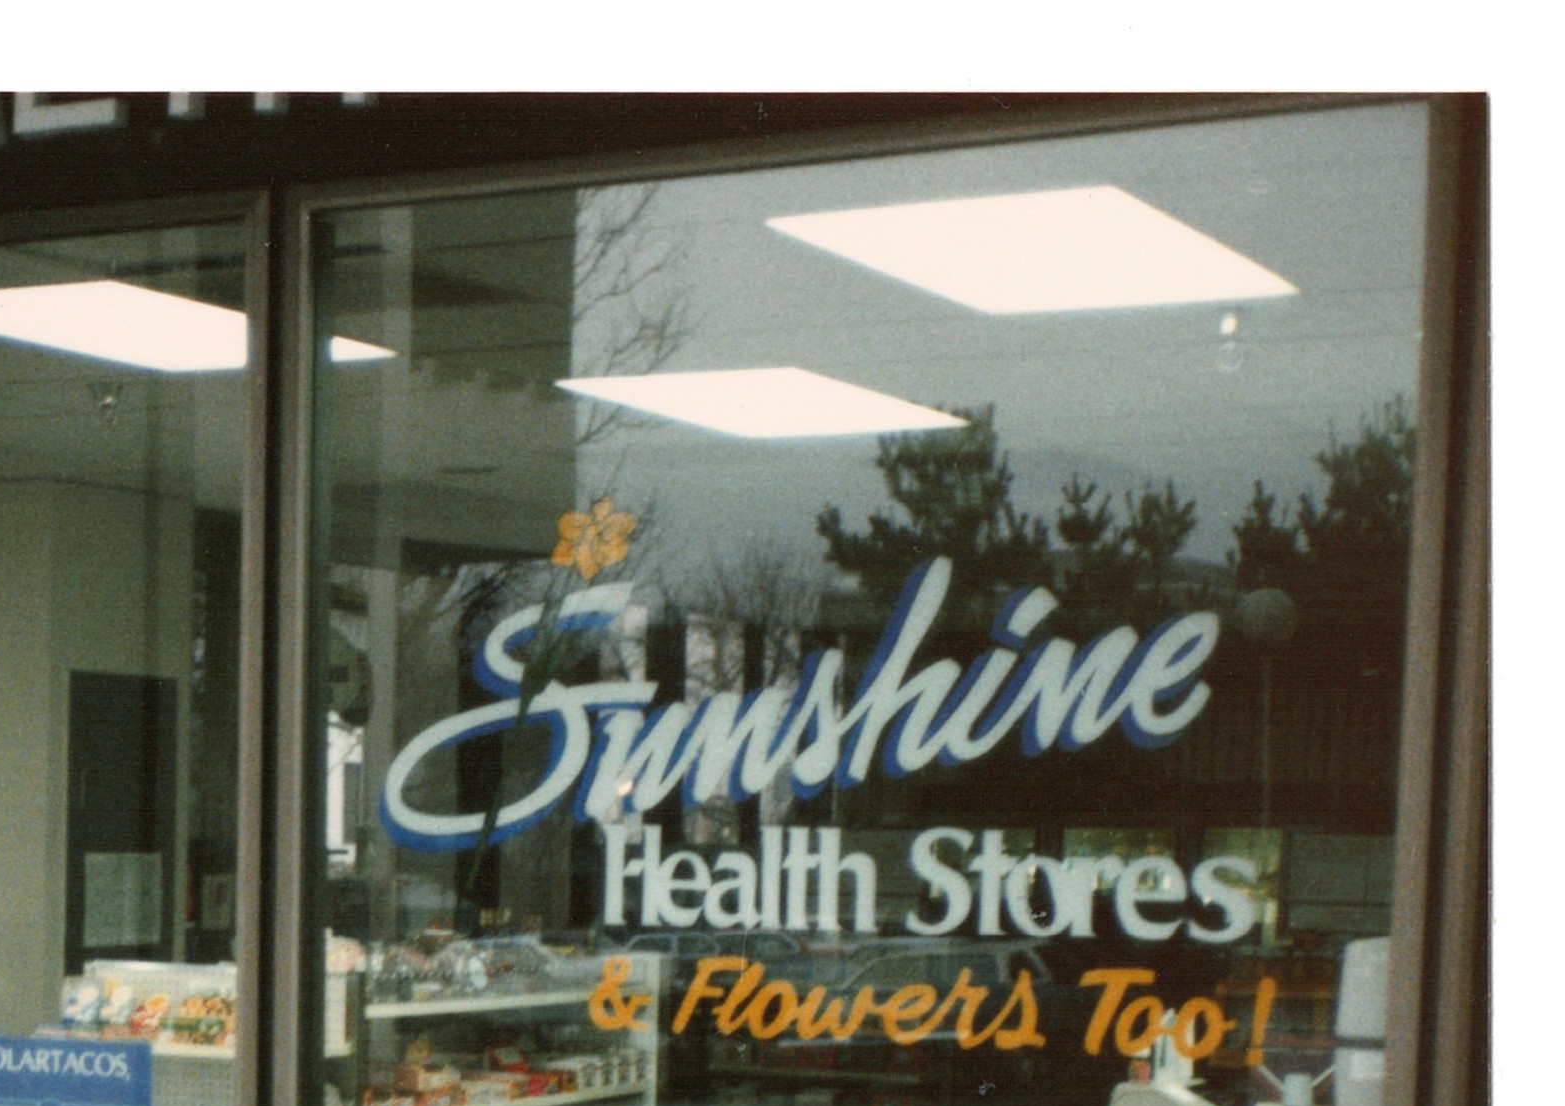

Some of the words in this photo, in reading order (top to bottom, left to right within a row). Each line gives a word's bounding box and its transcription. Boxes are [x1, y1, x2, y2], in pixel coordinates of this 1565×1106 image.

[380, 556, 1220, 852] Sunshine
[603, 825, 877, 932] Health
[907, 827, 1261, 942] Stores
[588, 955, 652, 1032] &
[670, 958, 1047, 1050] Flowers
